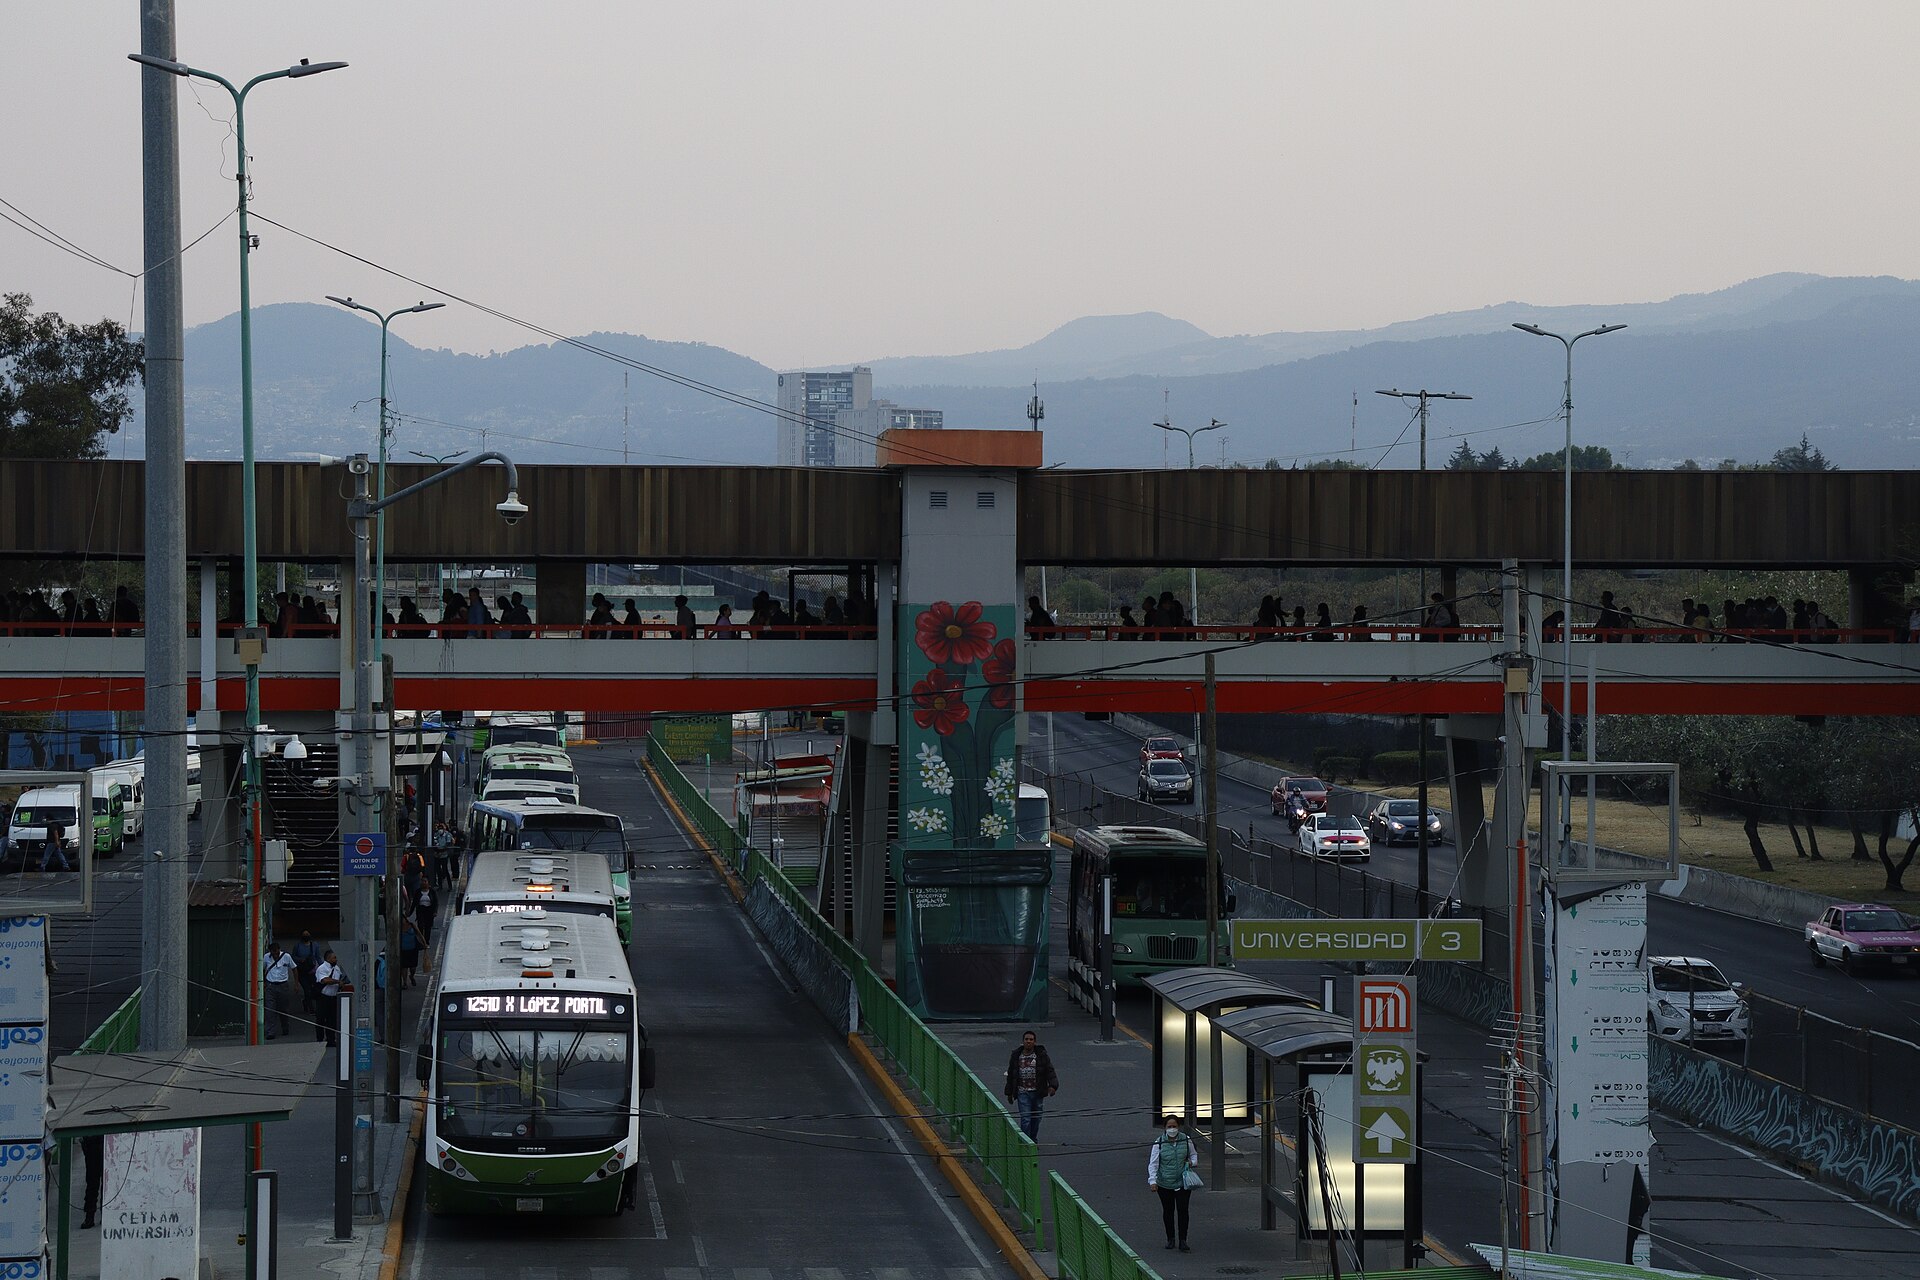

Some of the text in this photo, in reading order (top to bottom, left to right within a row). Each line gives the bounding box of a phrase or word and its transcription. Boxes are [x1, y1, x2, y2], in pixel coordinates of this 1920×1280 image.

[1240, 931, 1461, 951] UNIVERSIDAD 3
[505, 995, 515, 1012] X
[564, 996, 608, 1015] PORTIL
